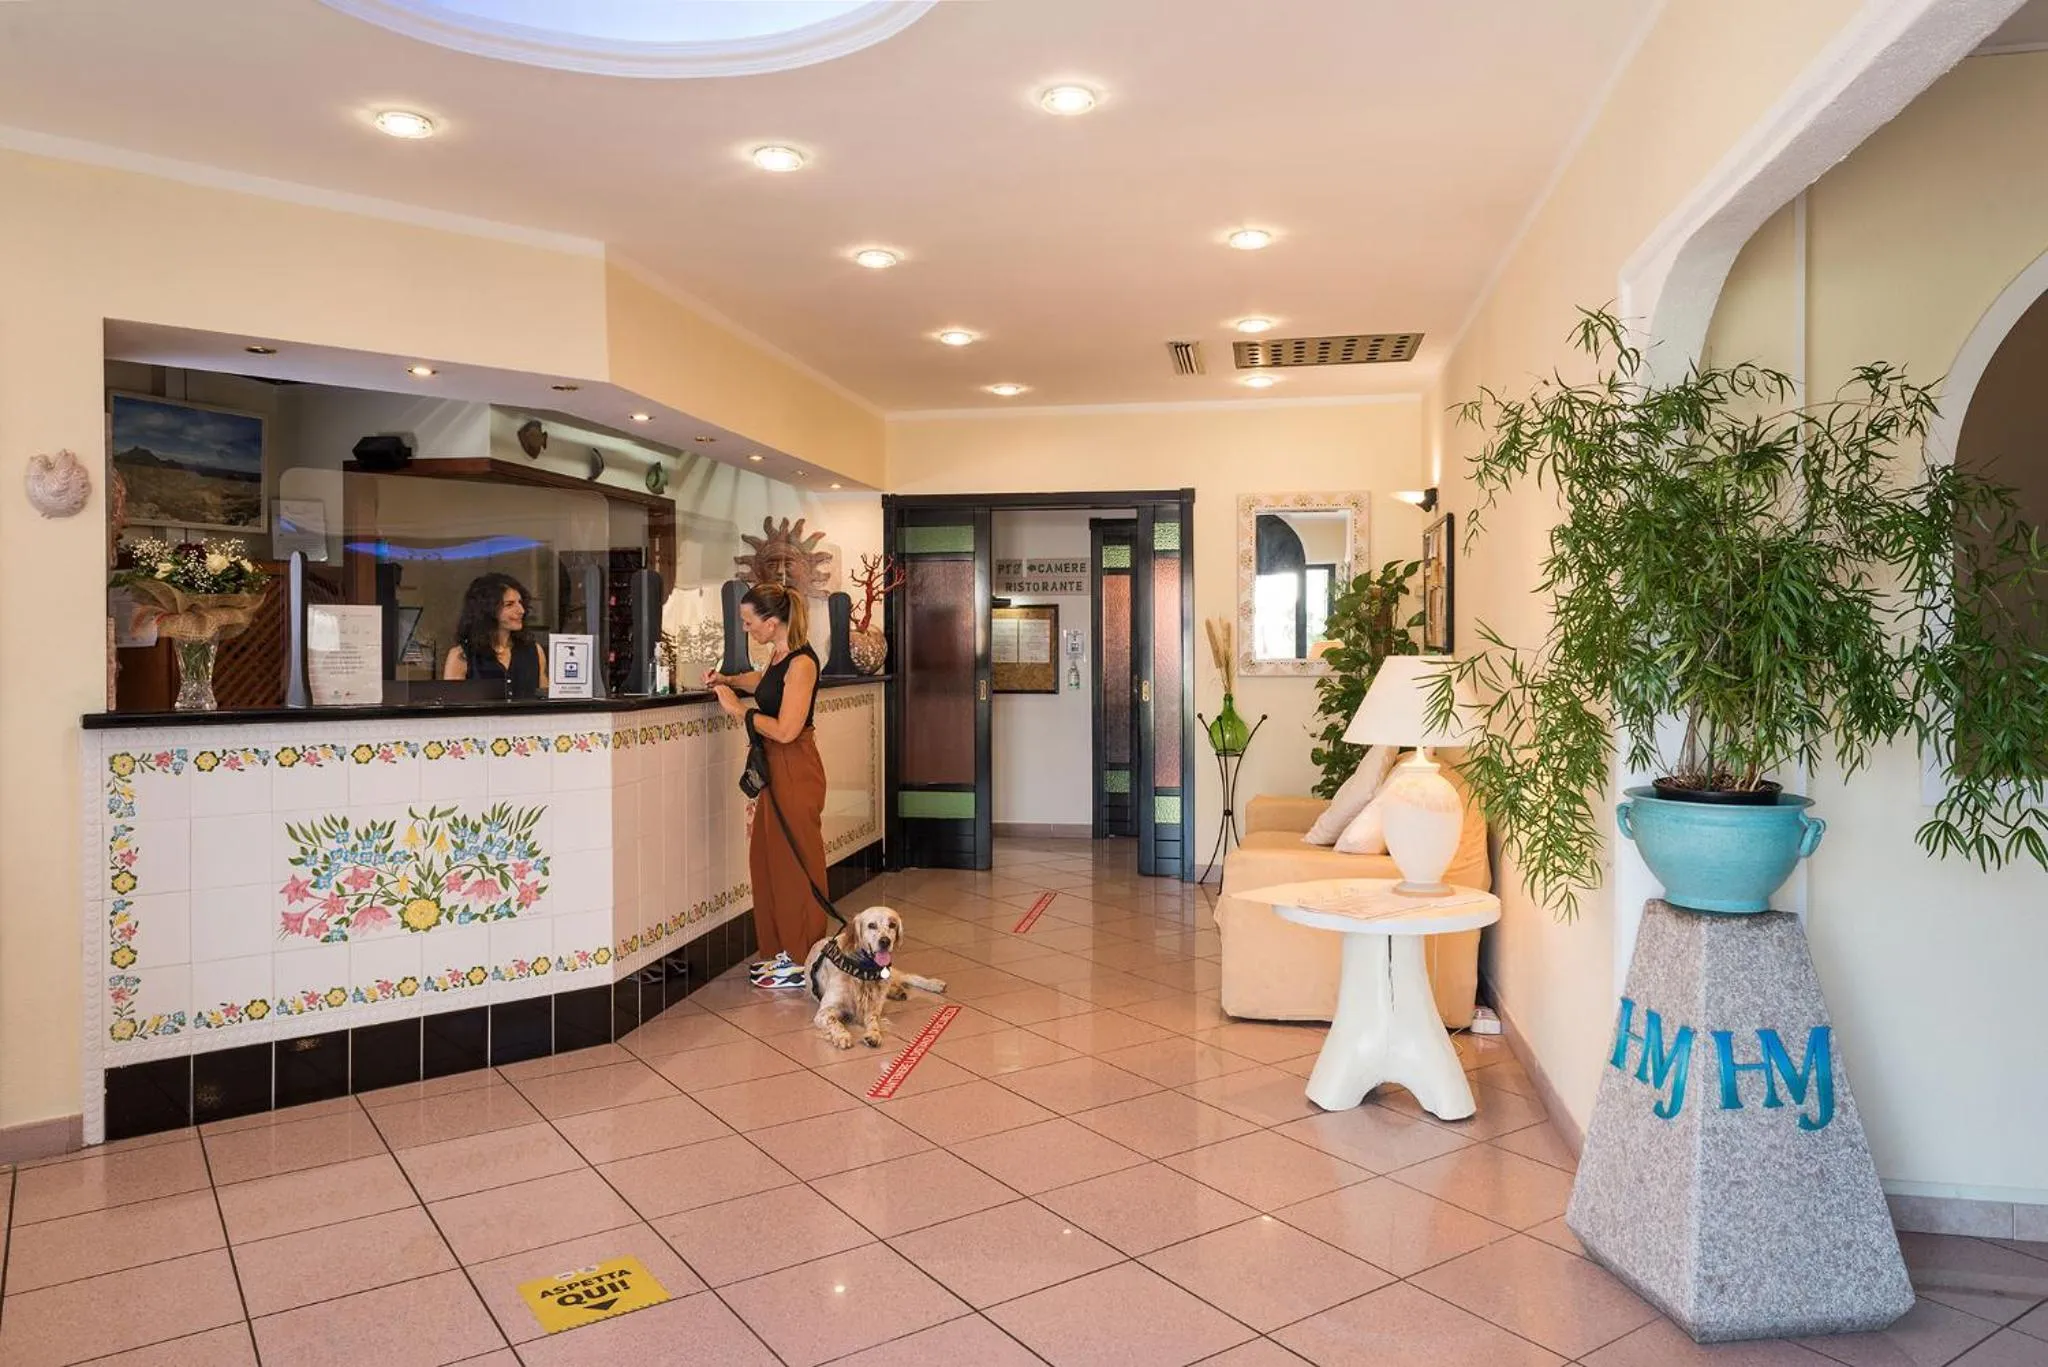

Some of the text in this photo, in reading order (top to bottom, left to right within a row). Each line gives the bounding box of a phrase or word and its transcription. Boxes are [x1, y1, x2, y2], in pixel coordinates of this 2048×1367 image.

[1038, 562, 1087, 574] CAMERE
[1005, 581, 1083, 593] RISTORANTE
[540, 1268, 633, 1299] ASPETTA
[556, 1279, 631, 1307] QUI!
